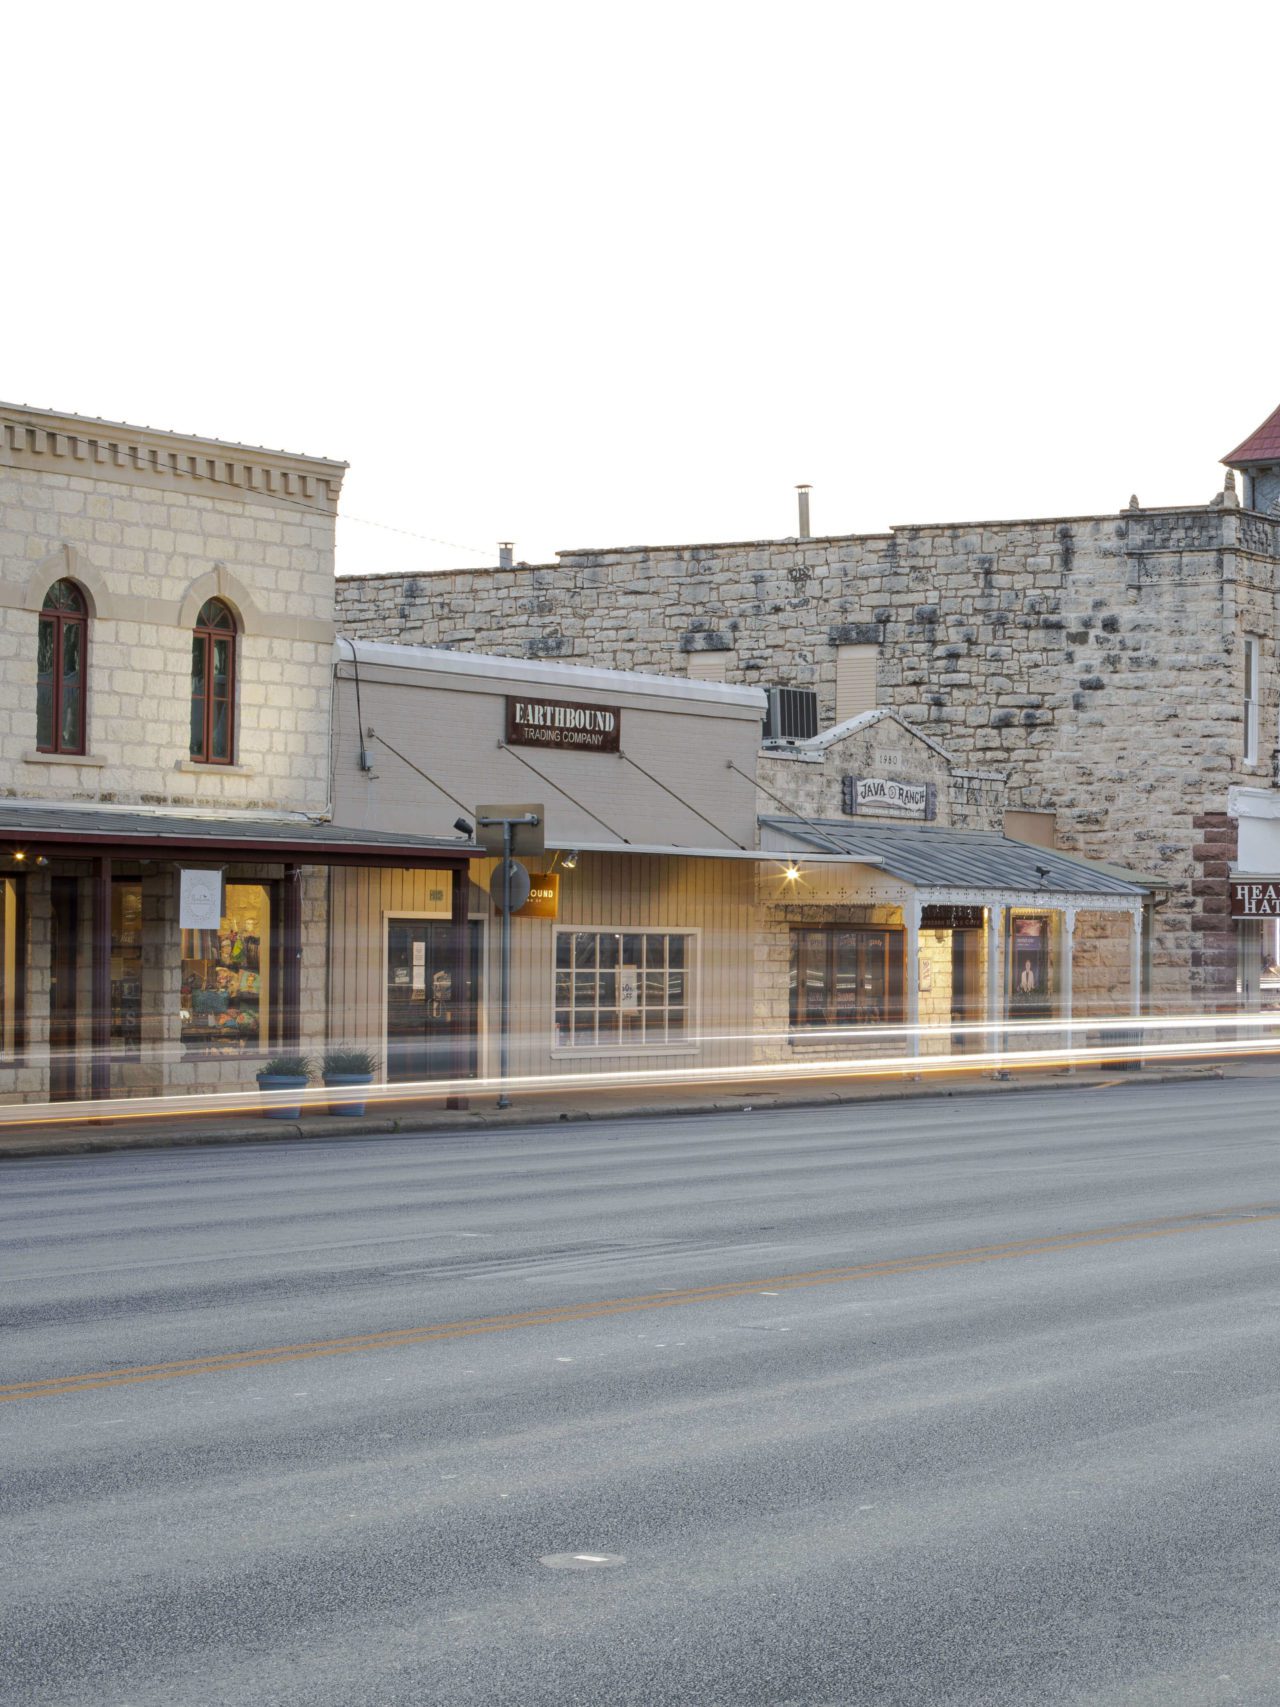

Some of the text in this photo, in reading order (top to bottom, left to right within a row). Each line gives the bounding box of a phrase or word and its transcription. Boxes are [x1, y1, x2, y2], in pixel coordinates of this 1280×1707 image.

[515, 703, 615, 732] EARTHBOUND
[523, 727, 604, 745] TRADING COMPANY
[860, 783, 925, 805] JAVA RANCH
